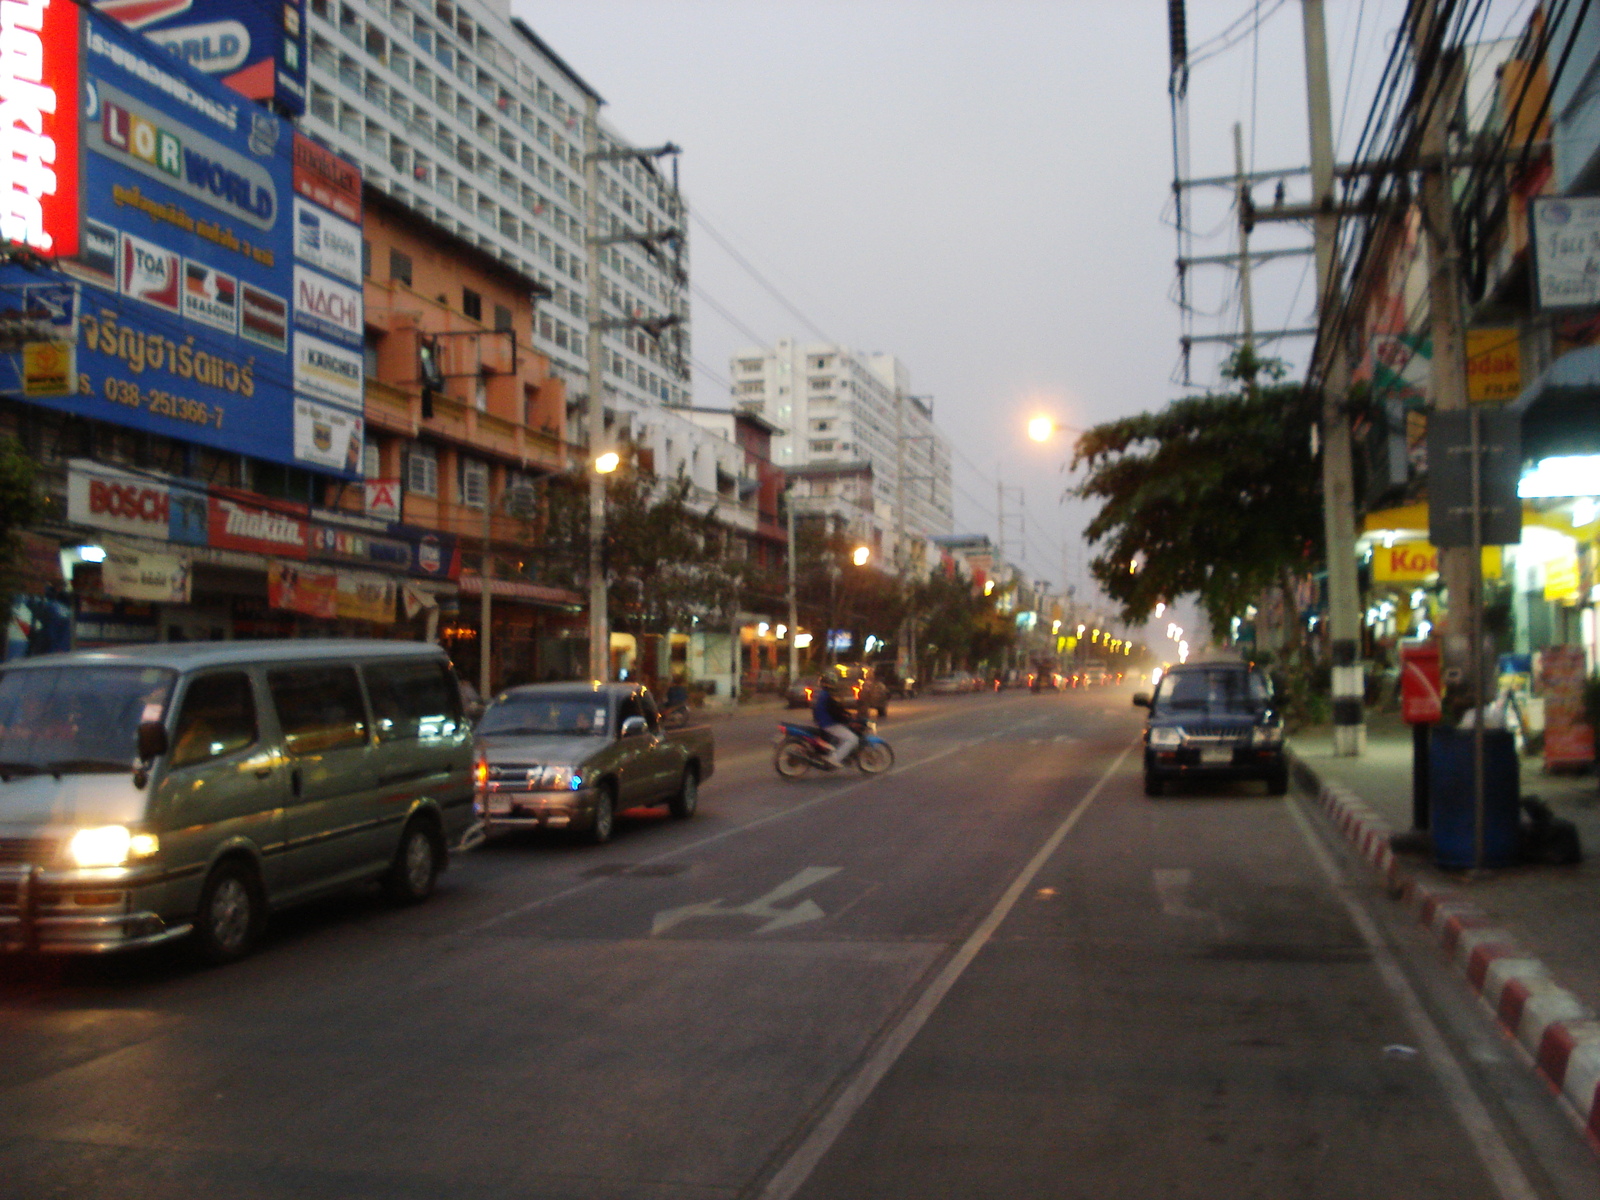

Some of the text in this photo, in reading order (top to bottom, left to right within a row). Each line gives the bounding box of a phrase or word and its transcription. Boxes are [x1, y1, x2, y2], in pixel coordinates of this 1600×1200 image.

[184, 146, 274, 221] WORLD
[136, 248, 166, 280] TOA
[1466, 353, 1516, 376] odak
[89, 479, 170, 525] BOSCH
